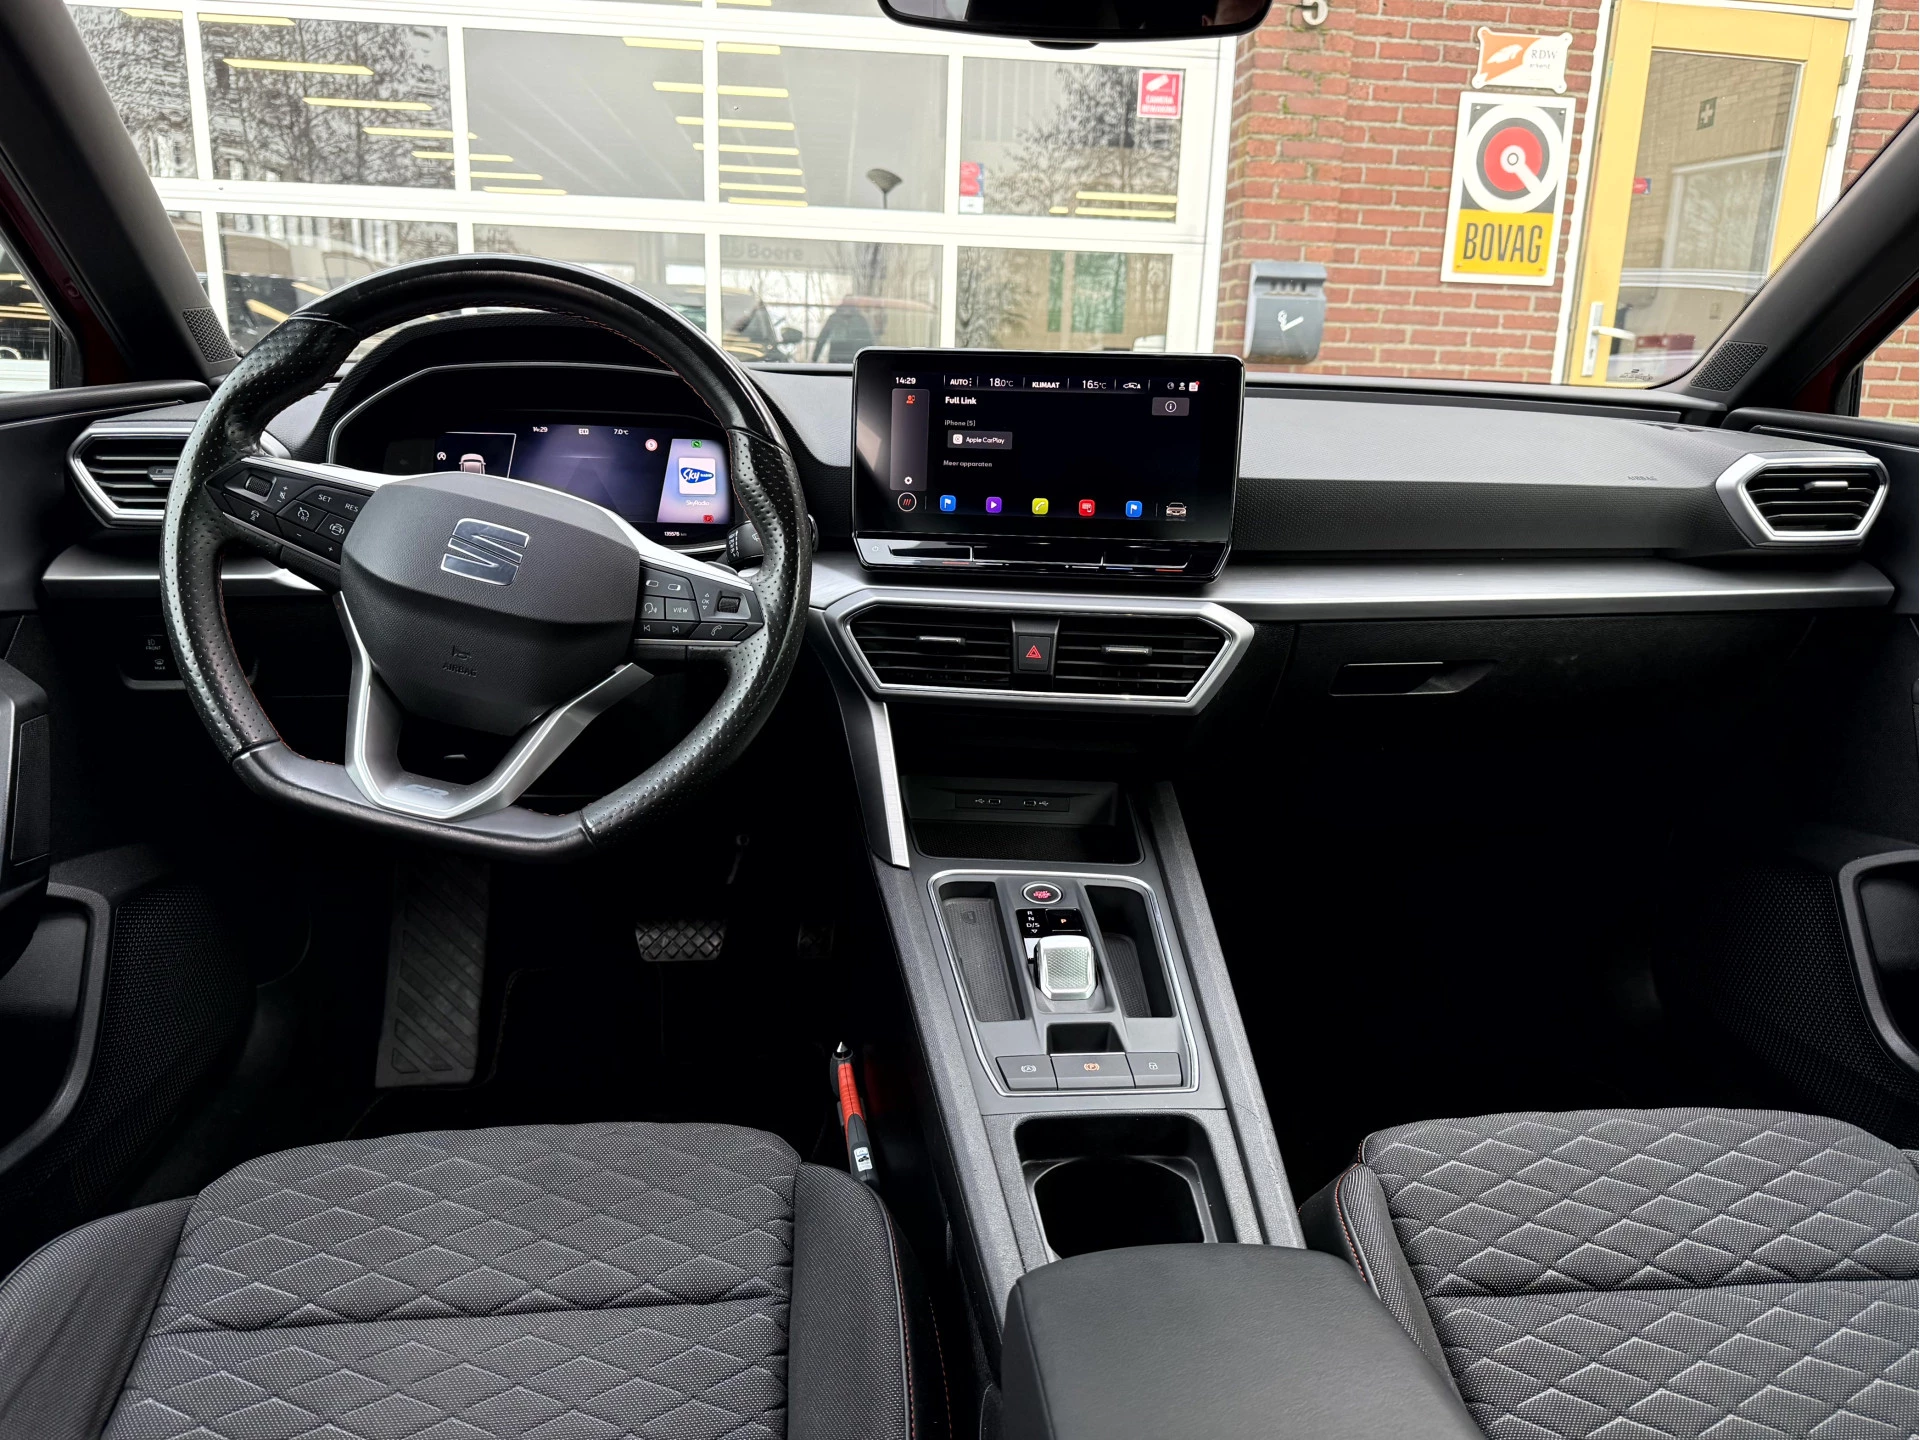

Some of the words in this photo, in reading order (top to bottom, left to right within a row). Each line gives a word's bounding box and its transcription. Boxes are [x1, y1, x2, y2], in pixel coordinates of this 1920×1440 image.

[1531, 49, 1558, 60] RDW
[1463, 223, 1543, 264] BOVAG
[895, 377, 917, 385] 14:29
[949, 378, 969, 386] AUTO
[1032, 381, 1060, 389] KLIMAAT
[945, 396, 960, 404] Full
[961, 397, 977, 405] Link
[982, 437, 1005, 445] CarPlay
[683, 468, 700, 483] Sky
[318, 493, 332, 503] SET
[344, 502, 359, 513] RES
[443, 663, 477, 678] AIRBAG
